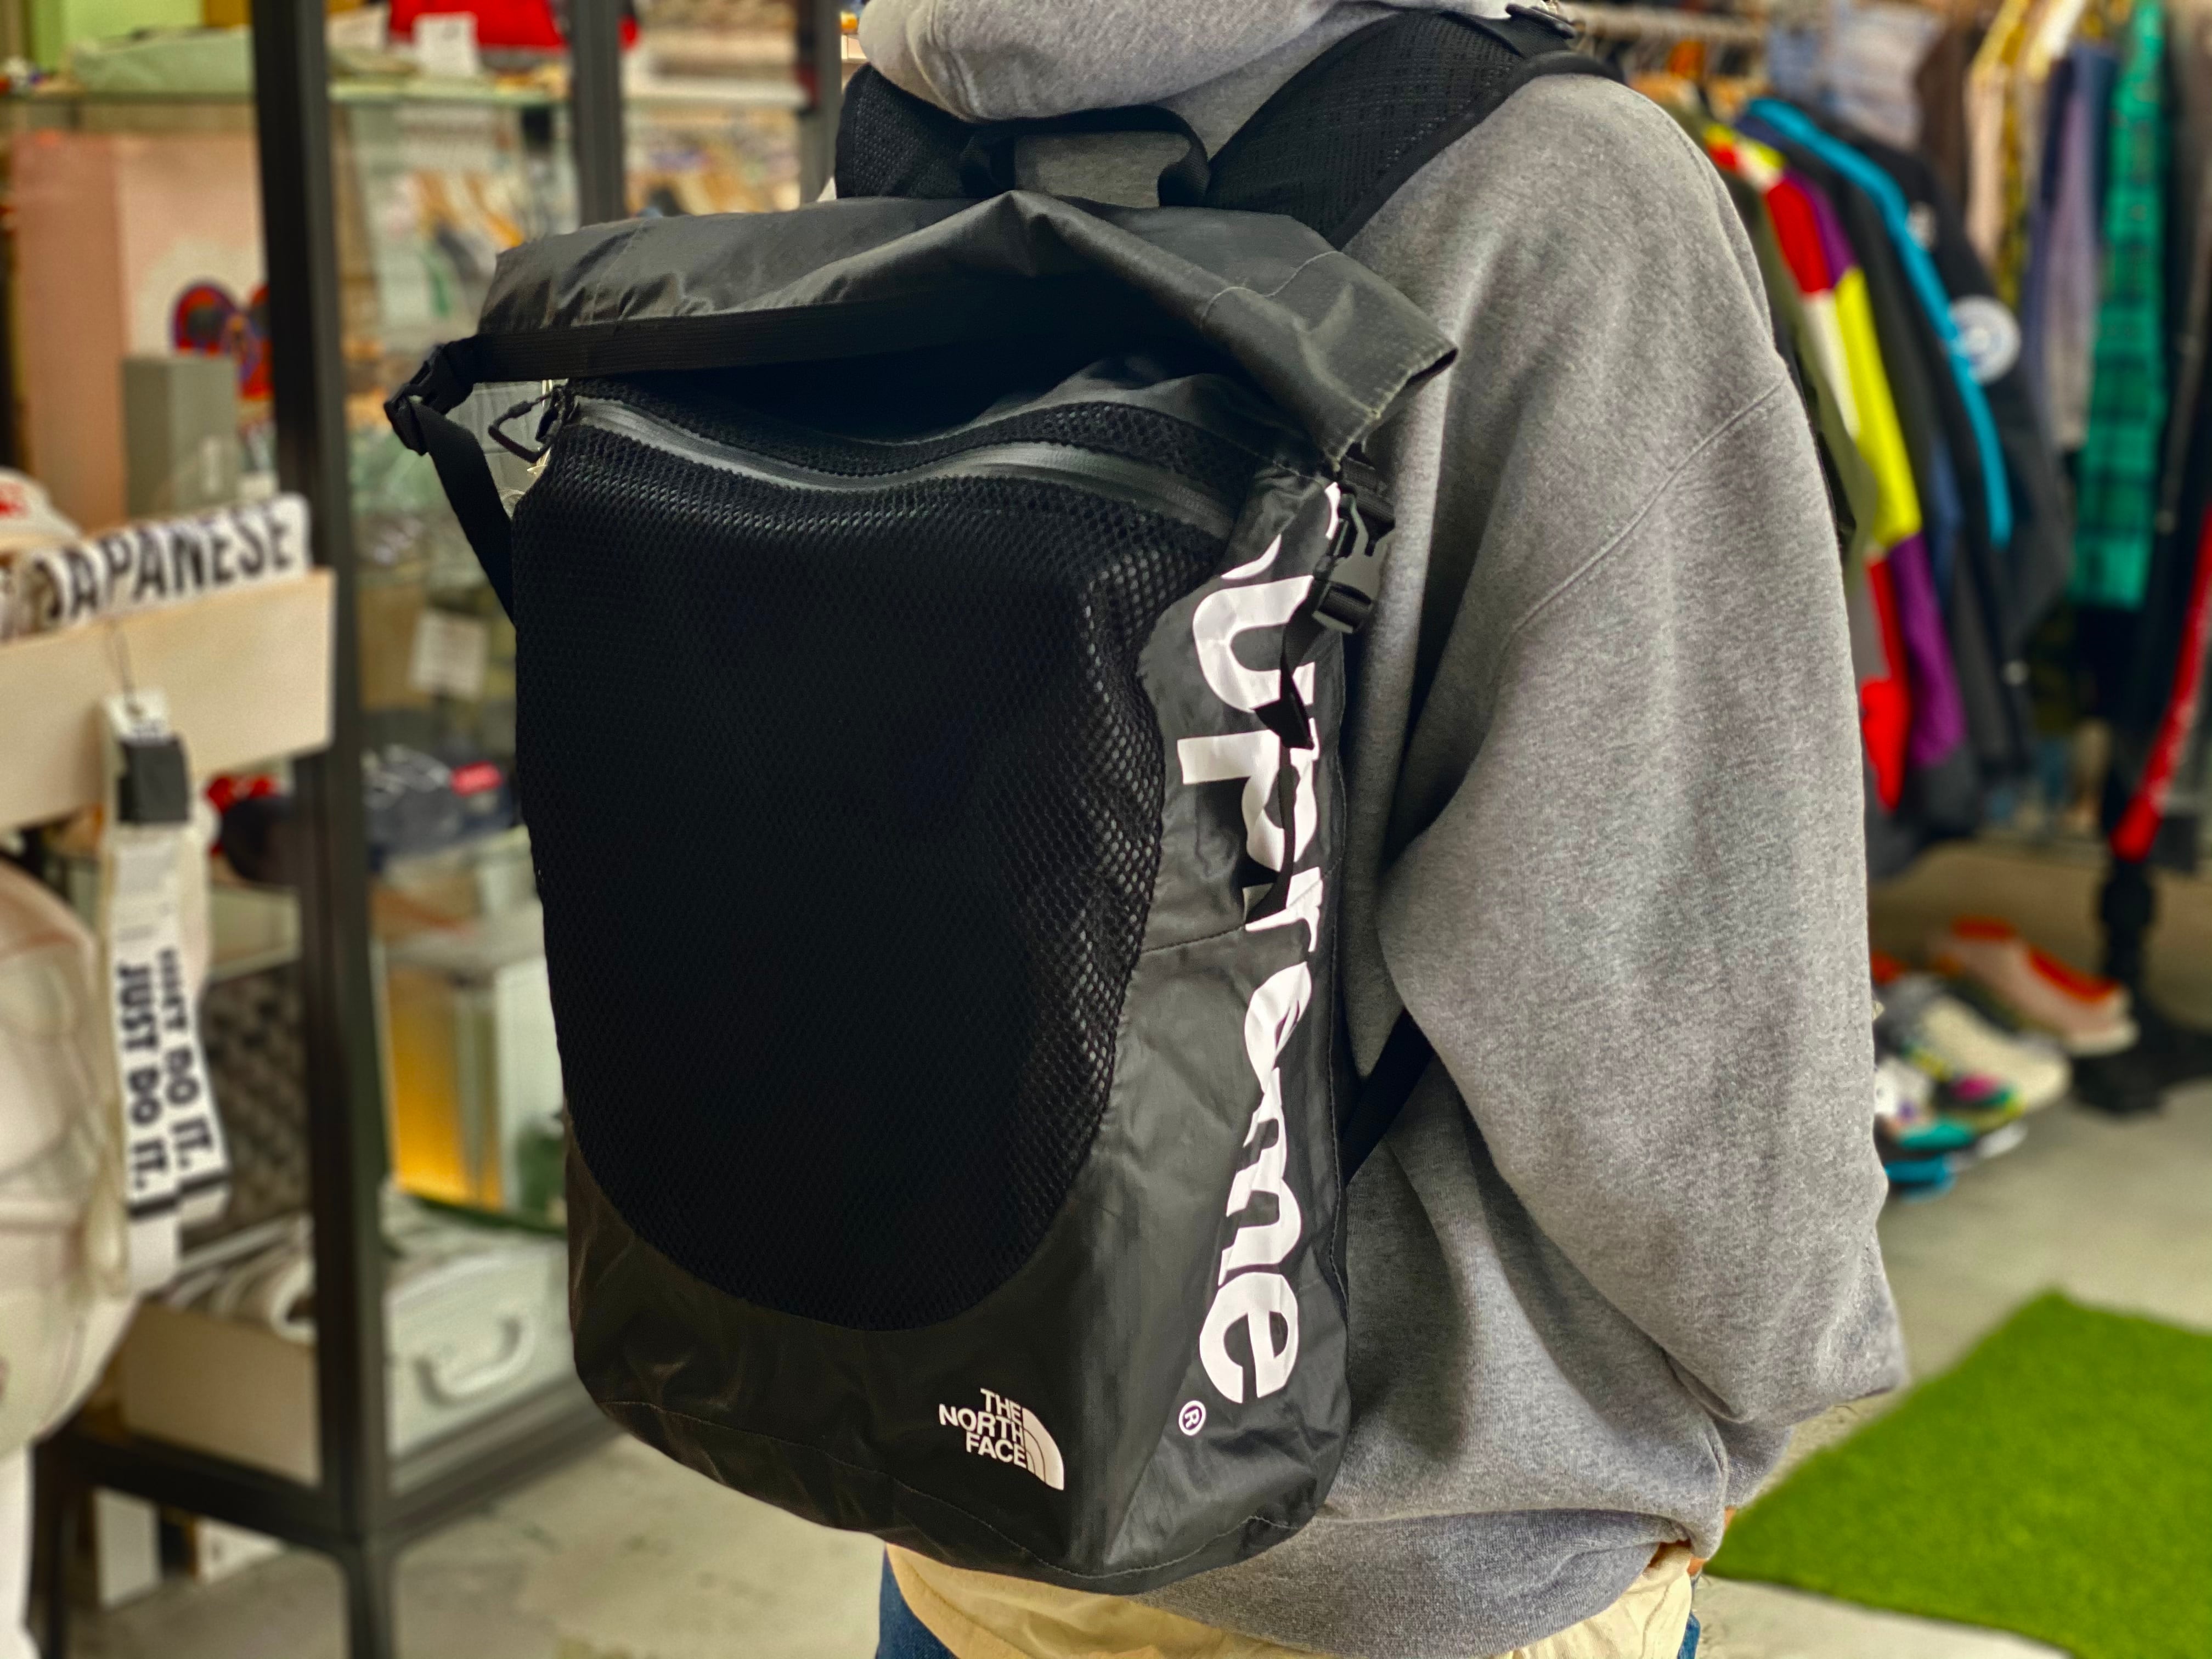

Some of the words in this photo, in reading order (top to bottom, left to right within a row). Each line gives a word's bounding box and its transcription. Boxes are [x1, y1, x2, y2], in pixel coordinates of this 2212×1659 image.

[32, 505, 292, 621] JAPANESE
[1177, 482, 1341, 1403] upreme
[117, 963, 158, 1050] JUST
[128, 1066, 163, 1125] DO
[166, 1047, 200, 1105] DO
[133, 1138, 167, 1189] IT.
[171, 1116, 213, 1169] IT.
[939, 1404, 1024, 1443] NORTH
[980, 1388, 1022, 1422] THE
[966, 1431, 1026, 1469] FACE
